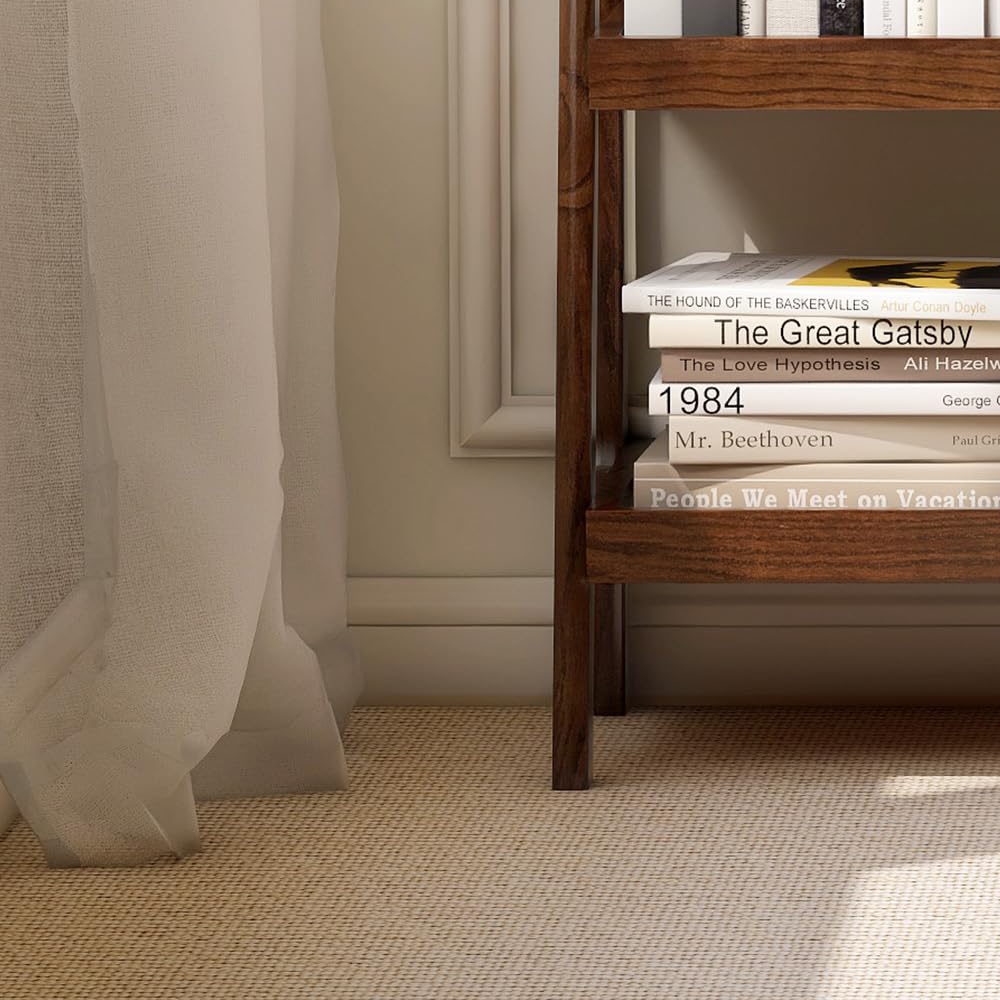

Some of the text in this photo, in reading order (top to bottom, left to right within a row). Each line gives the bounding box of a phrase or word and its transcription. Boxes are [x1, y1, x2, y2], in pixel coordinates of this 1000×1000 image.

[648, 295, 986, 316] THE HOUND OF THE BASKERVILLES Artur Conan Doyle
[714, 318, 972, 348] The Great Gatsby
[680, 358, 715, 372] The
[722, 358, 768, 372] Love
[776, 358, 880, 375] Hypothesis
[904, 356, 928, 370] Ali
[659, 386, 744, 414] 1984
[942, 394, 992, 409] George
[675, 432, 712, 448] Mr.
[721, 430, 833, 448] Beethoven
[952, 435, 978, 446] Paul
[650, 488, 732, 508] People
[742, 488, 777, 508] We
[788, 488, 848, 508] Meet
[858, 494, 887, 508] on
